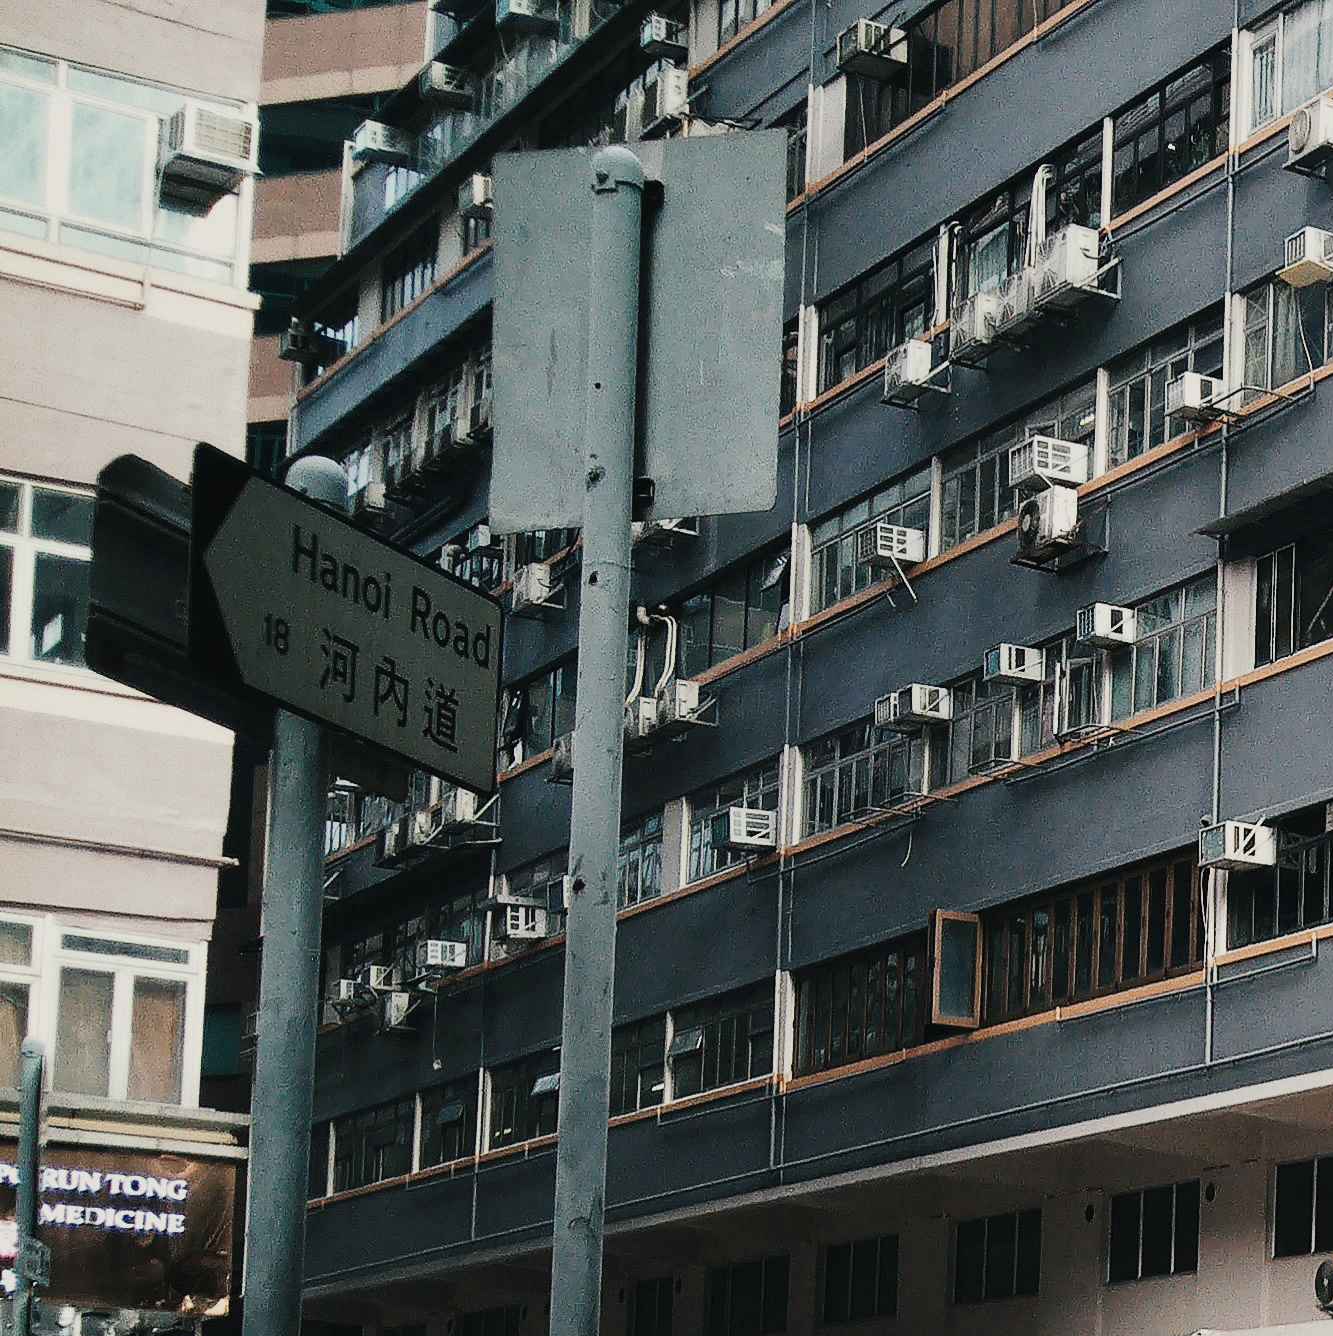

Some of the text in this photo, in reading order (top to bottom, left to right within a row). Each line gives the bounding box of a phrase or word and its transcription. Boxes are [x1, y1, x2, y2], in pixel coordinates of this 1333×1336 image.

[292, 525, 492, 669] Hanoi Road
[264, 612, 290, 655] 18
[106, 1173, 187, 1201] TONG
[39, 1203, 186, 1234] MEDICINE
